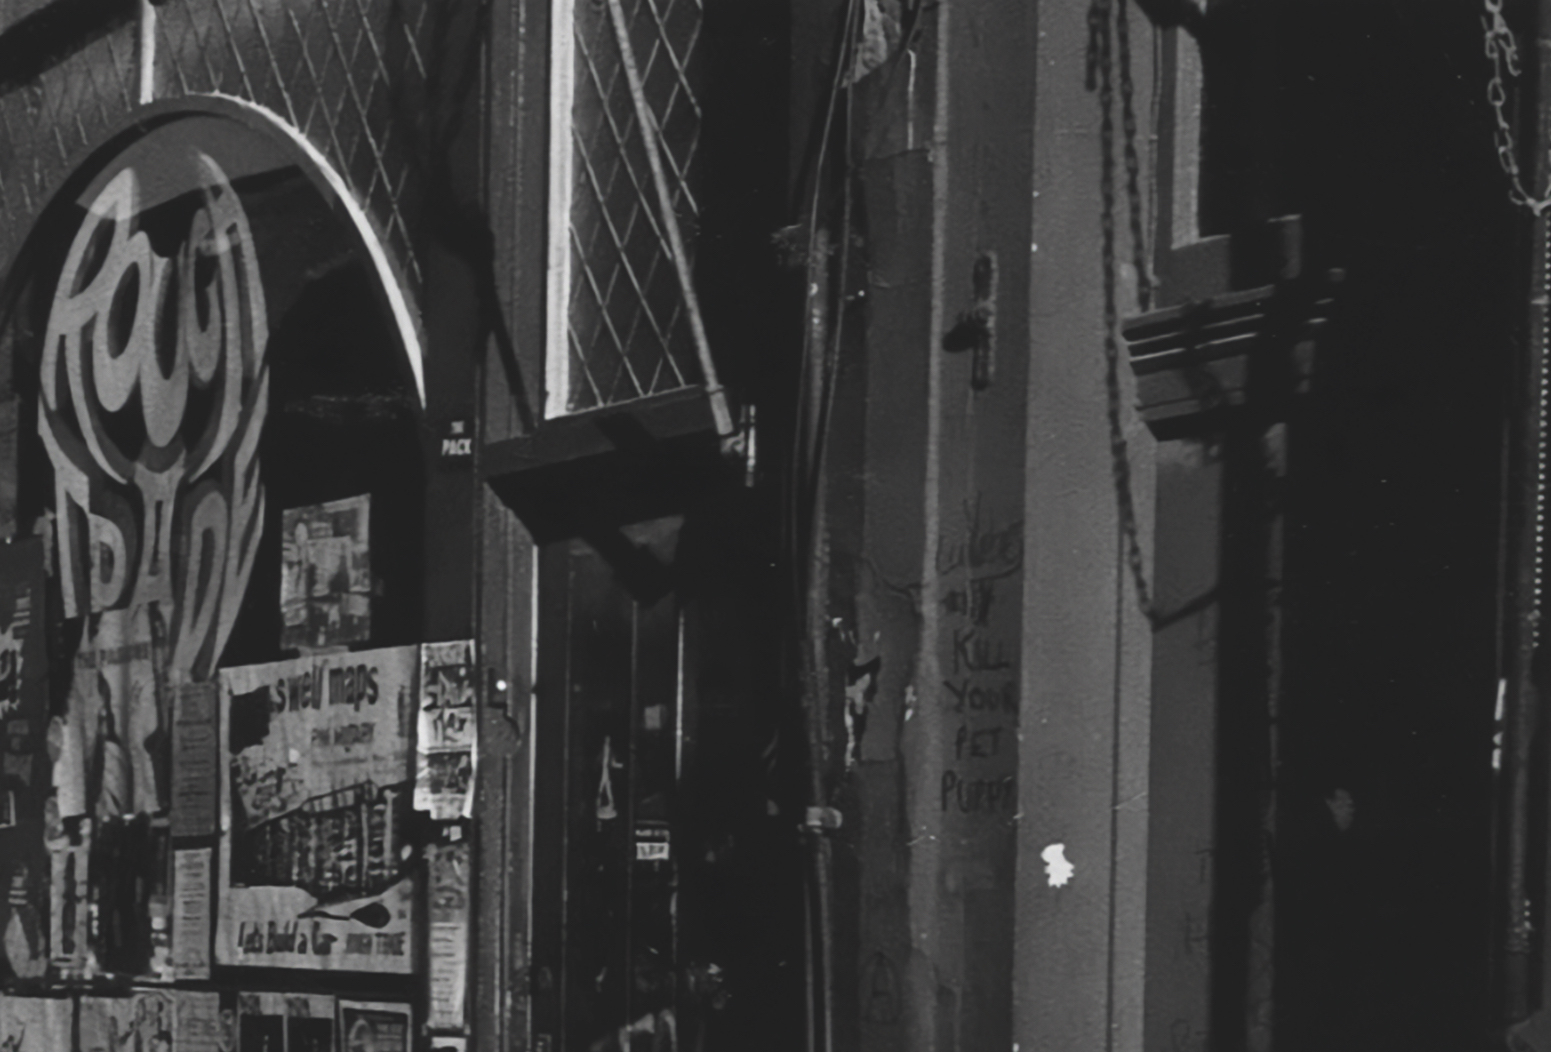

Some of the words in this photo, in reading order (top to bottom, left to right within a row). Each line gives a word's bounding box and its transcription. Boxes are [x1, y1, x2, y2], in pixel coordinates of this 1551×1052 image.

[953, 629, 1009, 673] KILL
[329, 664, 379, 712] maps
[943, 678, 1019, 713] YOUR
[954, 725, 1002, 760] PET
